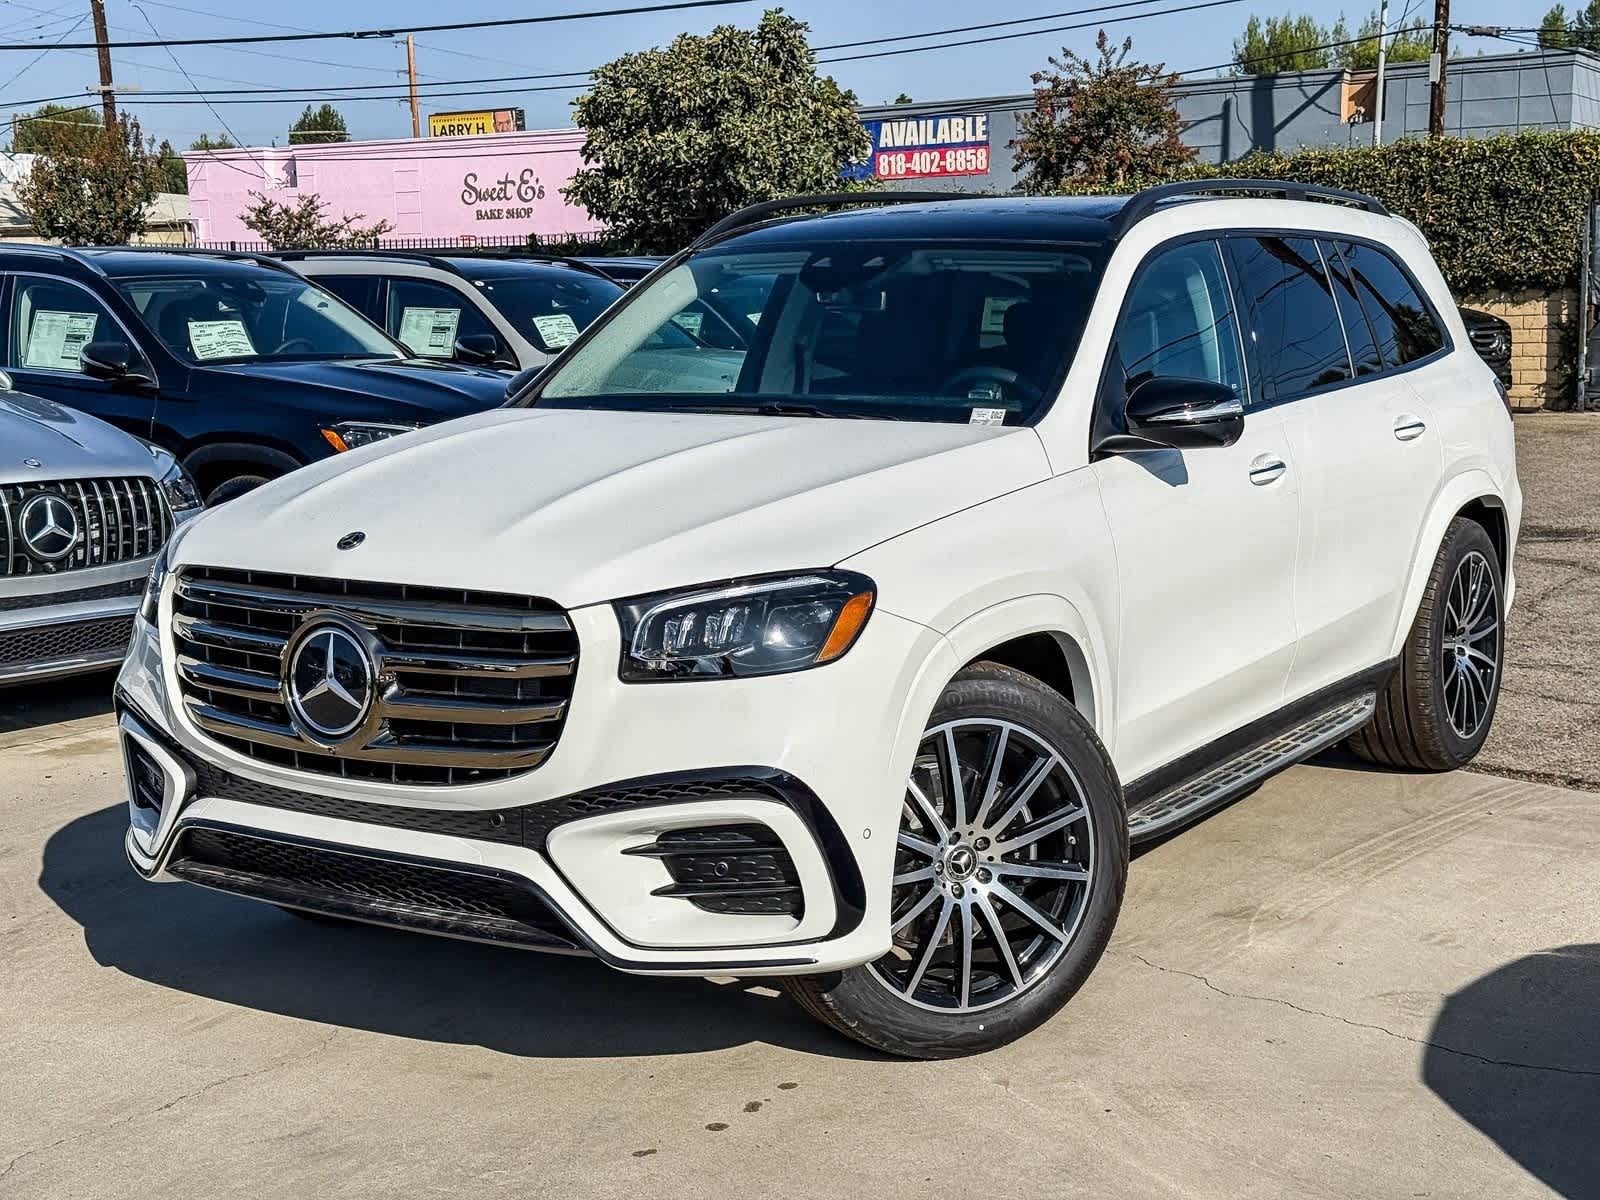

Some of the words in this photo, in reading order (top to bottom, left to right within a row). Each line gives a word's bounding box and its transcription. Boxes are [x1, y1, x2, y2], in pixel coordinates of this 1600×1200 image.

[433, 123, 472, 137] LARRY
[879, 116, 987, 148] AVAILABLE
[878, 149, 987, 176] 818-402-8858
[461, 172, 516, 206] Sweet
[517, 168, 545, 203] E's
[476, 208, 504, 220] BAKE
[505, 207, 533, 219] SHOP
